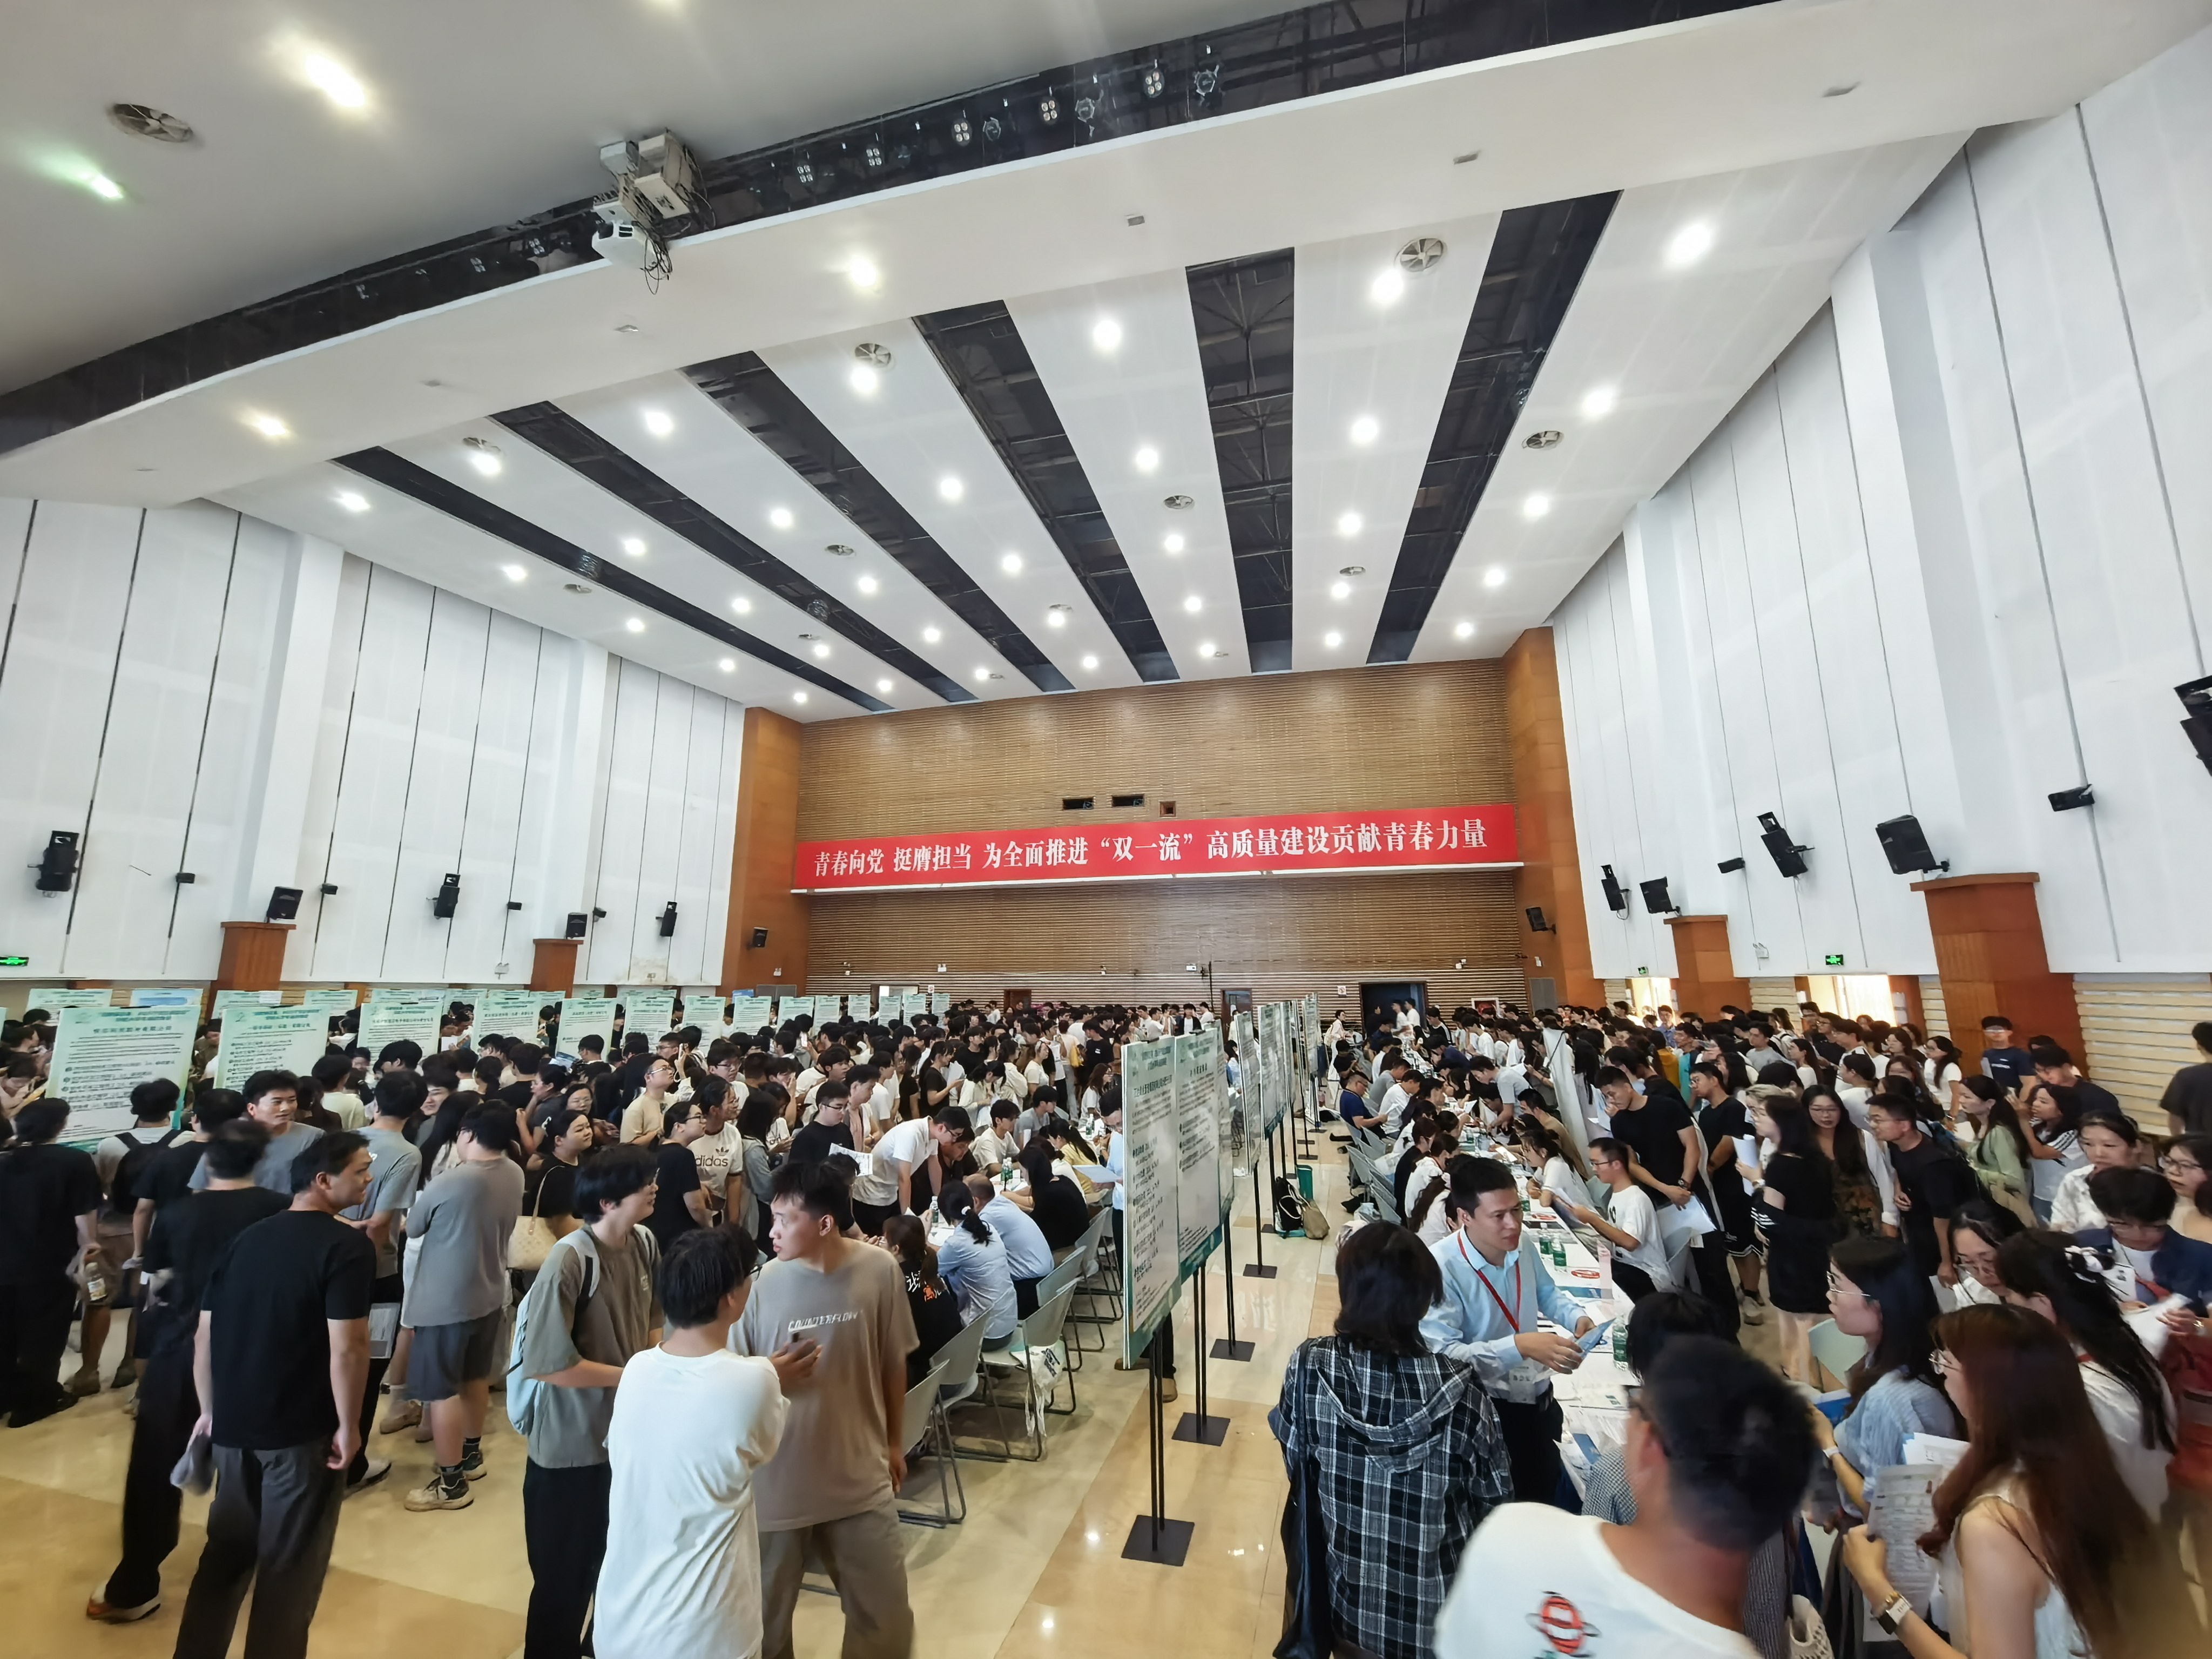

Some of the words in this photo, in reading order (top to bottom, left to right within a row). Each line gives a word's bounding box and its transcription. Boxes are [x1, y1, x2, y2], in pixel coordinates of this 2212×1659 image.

[814, 848, 884, 876] 青春向党
[893, 843, 971, 872] 挺膺担当
[696, 1155, 729, 1167] didas
